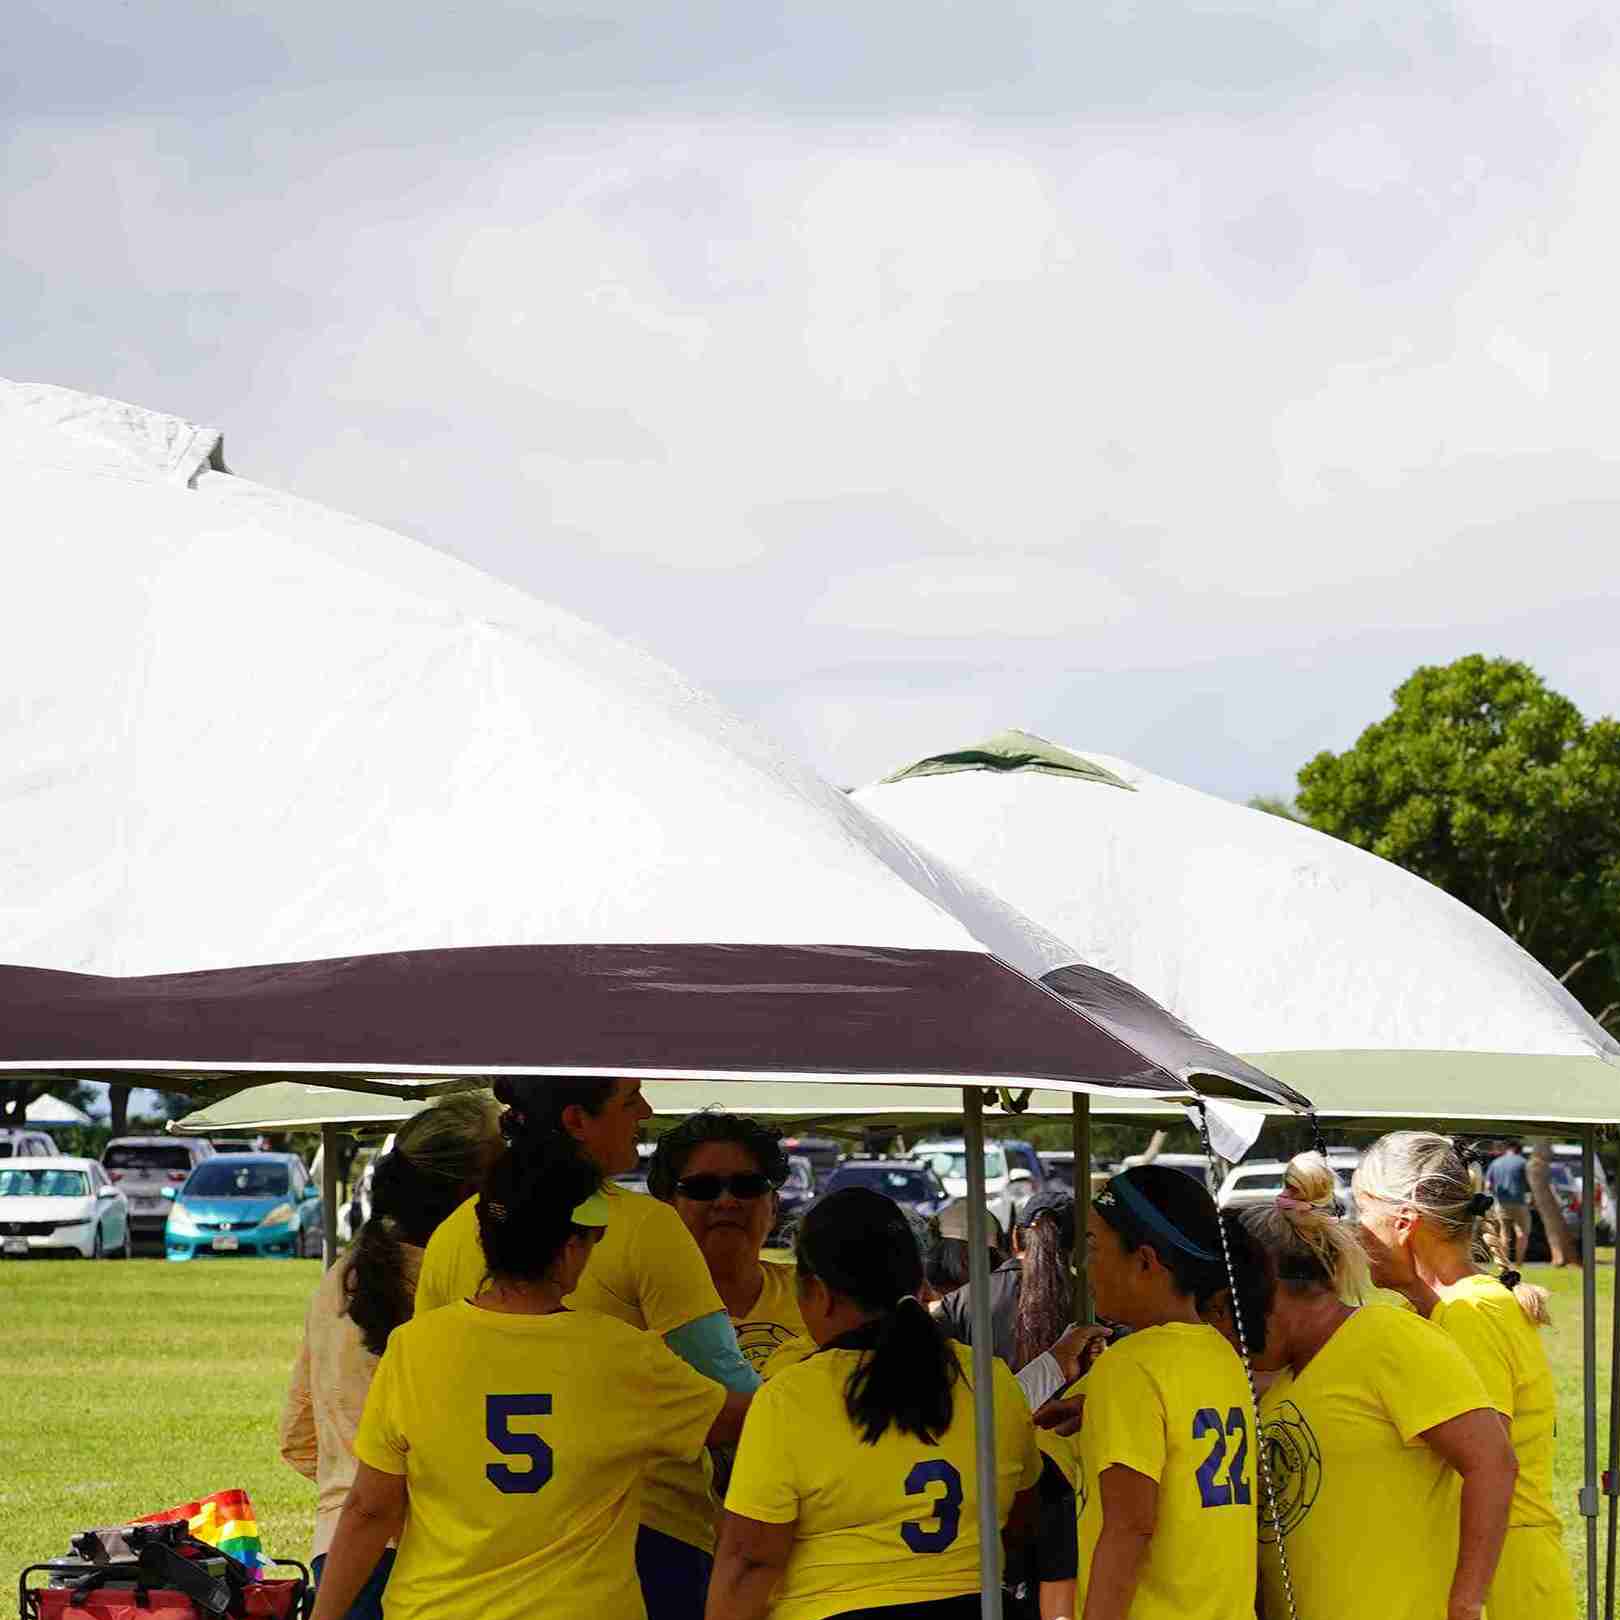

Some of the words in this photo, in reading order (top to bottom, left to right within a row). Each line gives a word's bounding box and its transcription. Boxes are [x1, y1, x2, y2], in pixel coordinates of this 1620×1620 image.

[486, 1394, 553, 1493] 5
[1192, 1407, 1251, 1508] 22
[901, 1460, 963, 1553] 3
